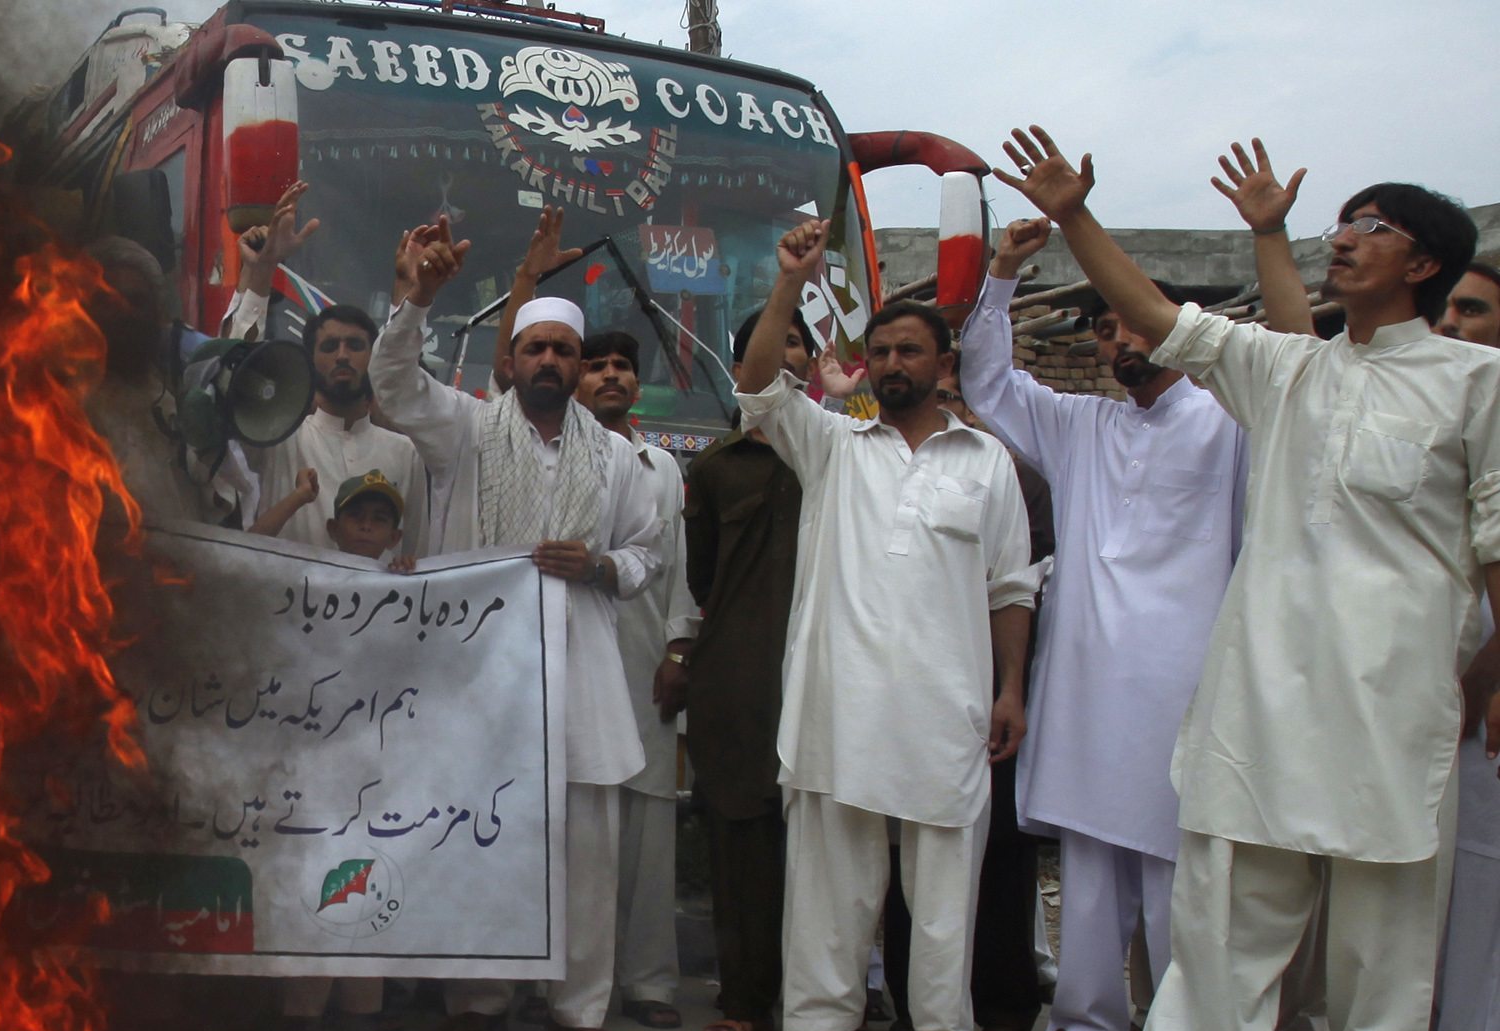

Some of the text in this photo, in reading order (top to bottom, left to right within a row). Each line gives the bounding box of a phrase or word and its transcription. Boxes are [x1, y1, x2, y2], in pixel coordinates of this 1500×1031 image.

[275, 33, 837, 148] SAEED COACH
[274, 576, 505, 643] مردہ باد مردہ باد
[147, 673, 226, 724] شان
[225, 676, 282, 729] میں
[279, 670, 379, 739] امریکہ
[380, 687, 419, 750] ہم
[213, 795, 267, 848] ہیں
[274, 778, 382, 836] کرتے
[473, 778, 515, 847] کی
